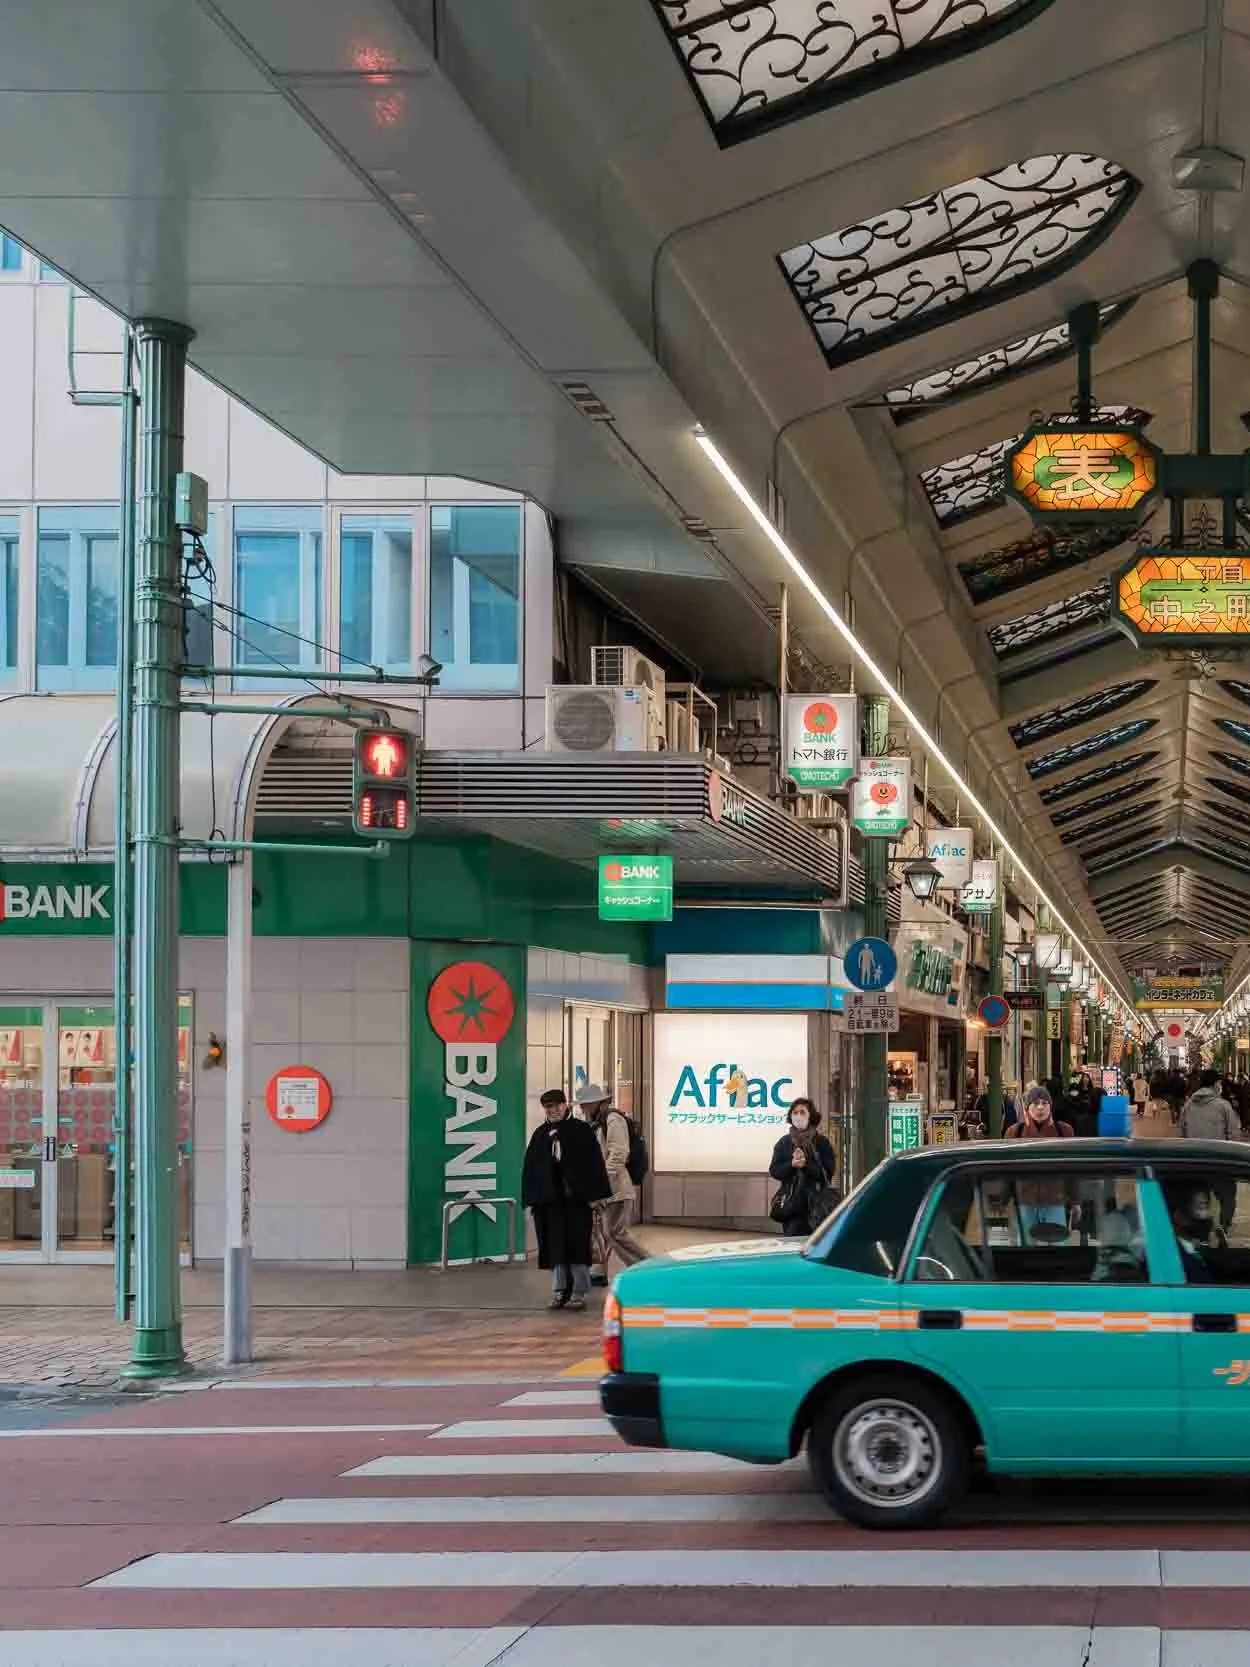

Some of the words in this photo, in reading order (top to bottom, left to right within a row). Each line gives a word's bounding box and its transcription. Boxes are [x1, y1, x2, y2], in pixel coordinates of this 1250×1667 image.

[1048, 444, 1121, 500] 表
[803, 733, 837, 743] BANK
[793, 748, 848, 760] トマト銀行
[622, 865, 660, 879] BANK
[5, 885, 112, 918] BANK
[1146, 988, 1215, 1000] インターネットカフェ
[445, 1042, 497, 1224] BANK
